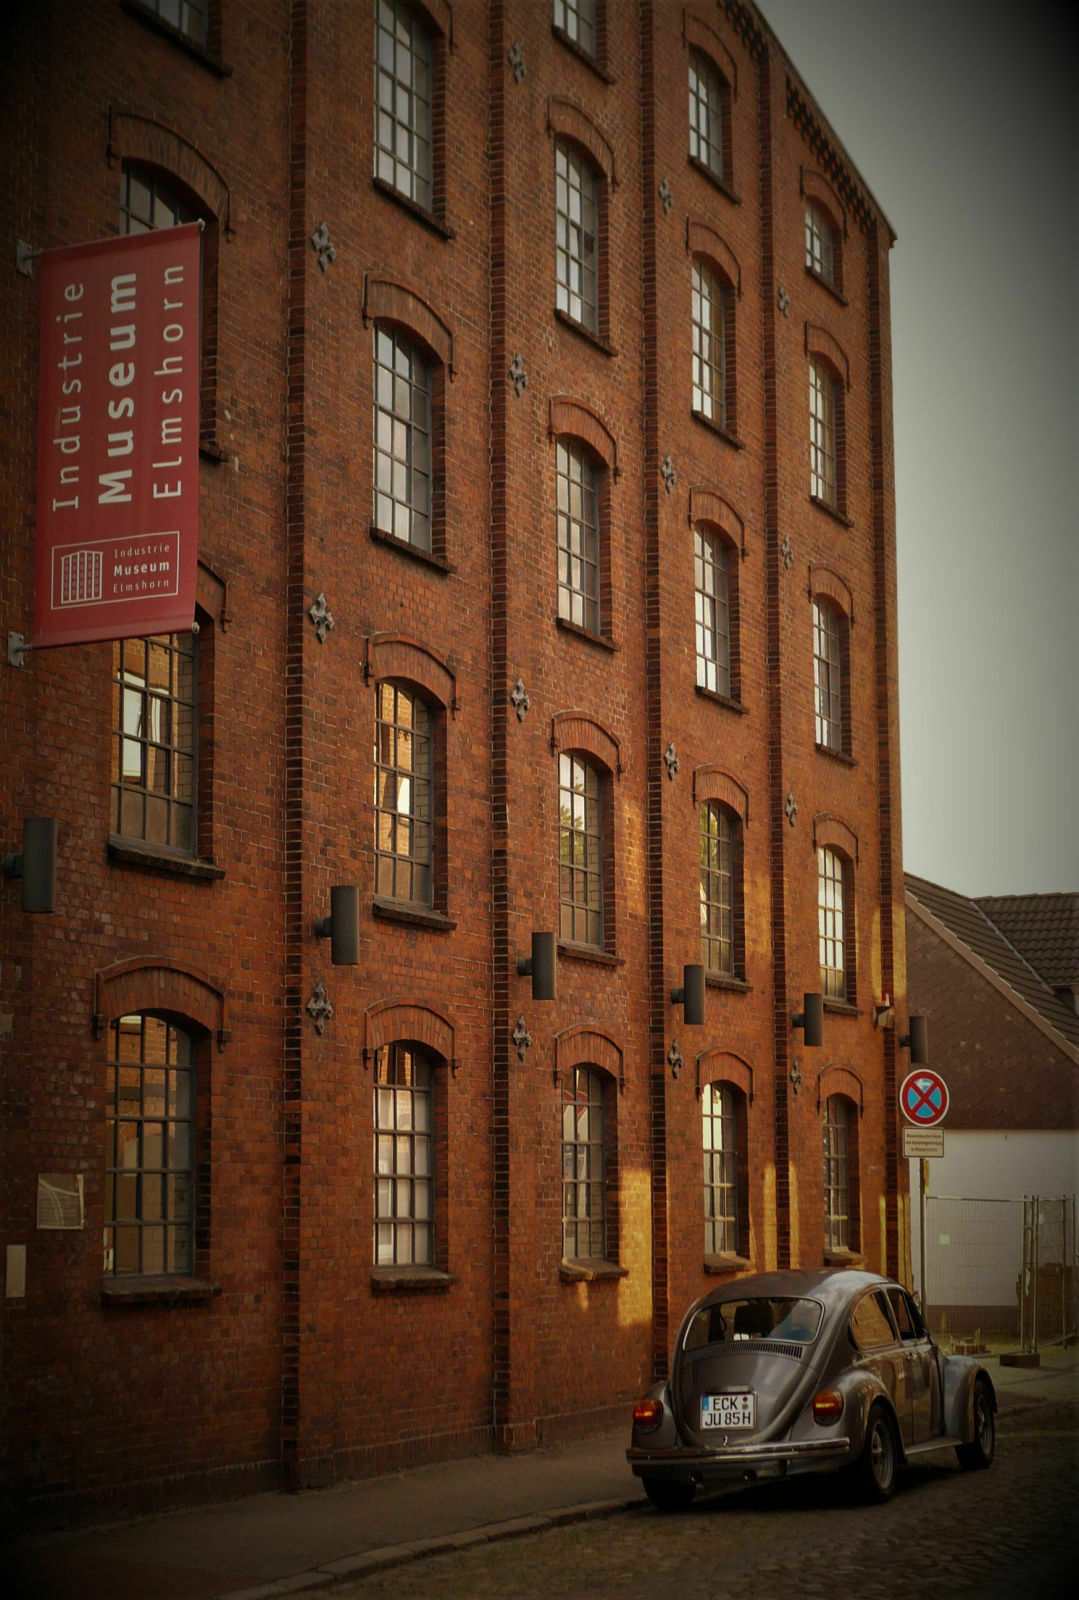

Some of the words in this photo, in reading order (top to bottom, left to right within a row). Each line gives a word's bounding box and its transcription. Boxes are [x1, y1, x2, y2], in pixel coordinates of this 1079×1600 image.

[98, 273, 136, 505] Museum
[153, 265, 184, 499] Elmshorn
[53, 281, 84, 511] Industrie
[114, 542, 170, 558] Industrie
[113, 561, 170, 576] Museum
[113, 579, 169, 593] Elmshorn
[713, 1397, 738, 1411] ECK
[705, 1413, 721, 1425] JU
